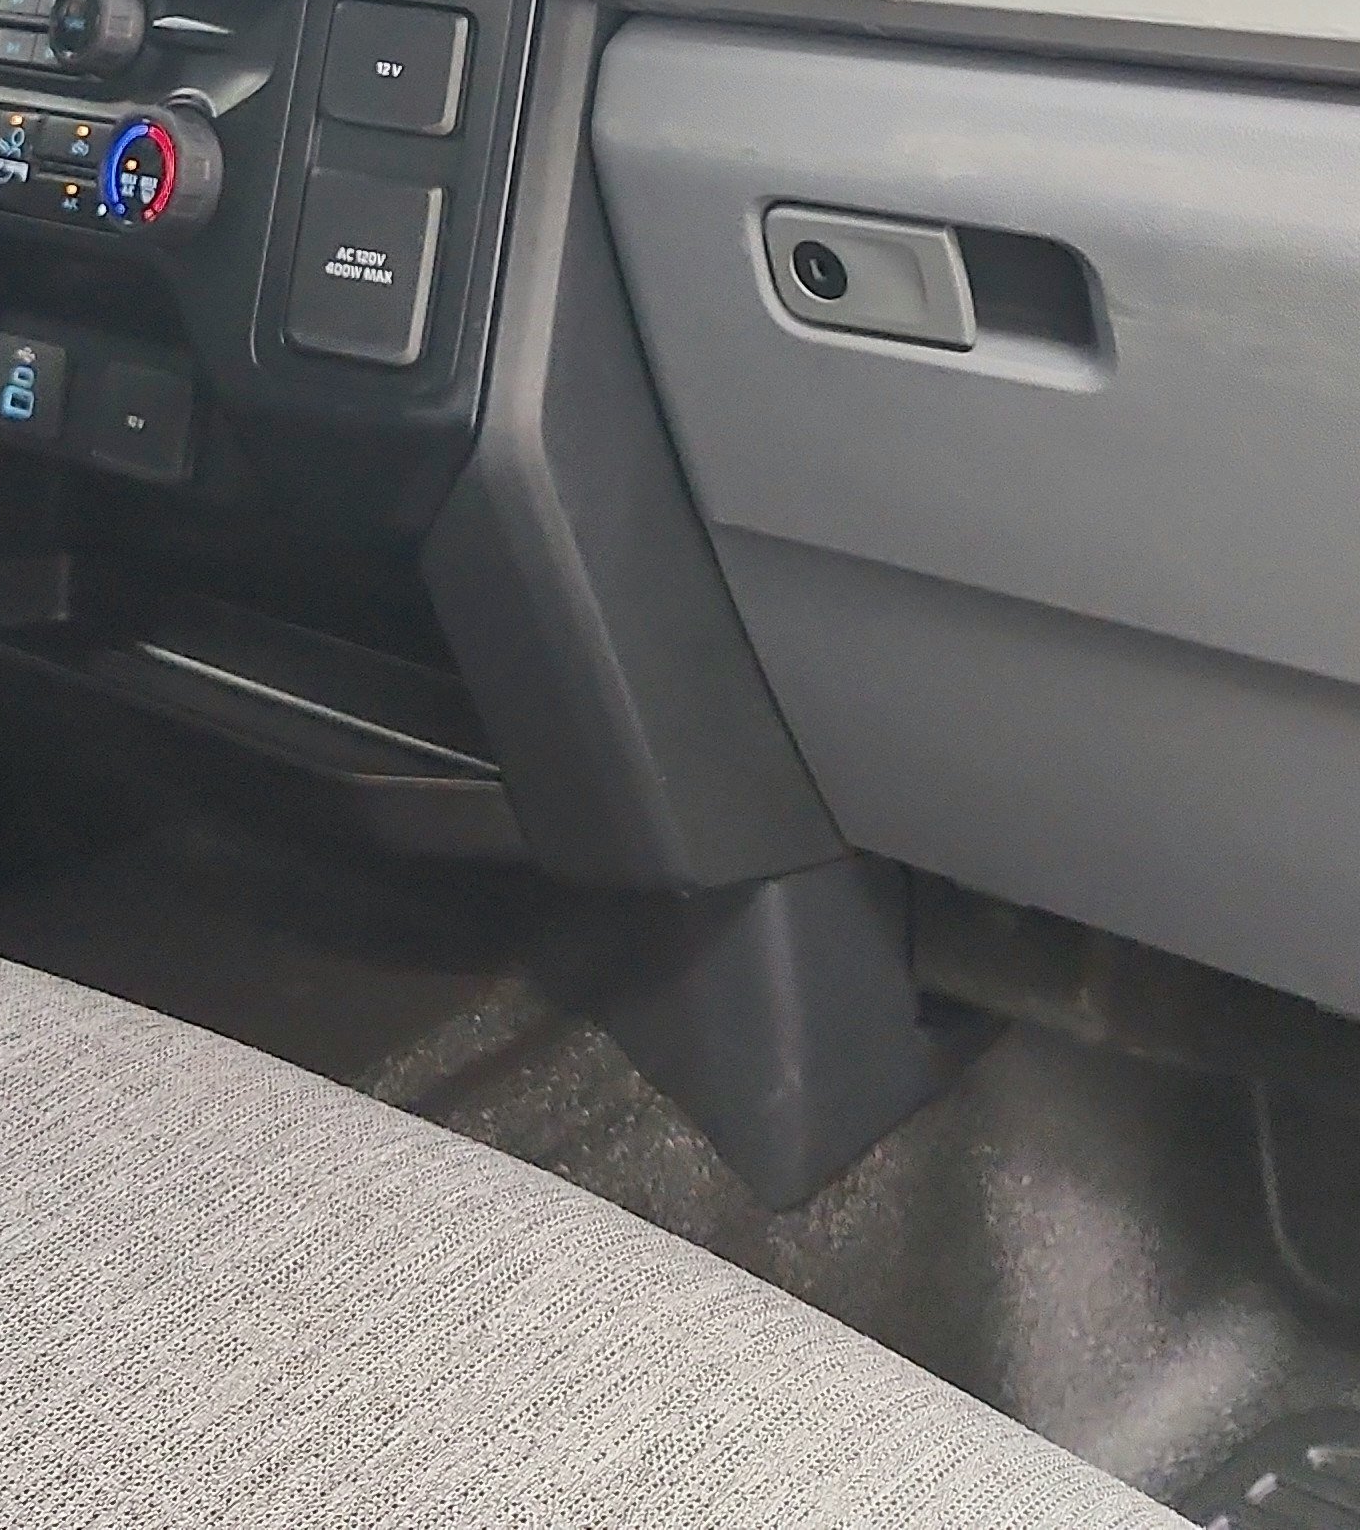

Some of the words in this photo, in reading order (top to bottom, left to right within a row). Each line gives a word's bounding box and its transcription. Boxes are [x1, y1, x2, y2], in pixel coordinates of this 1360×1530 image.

[336, 246, 355, 262] AC
[356, 249, 387, 267] 120V
[325, 261, 362, 279] 400W
[362, 267, 393, 284] MAX
